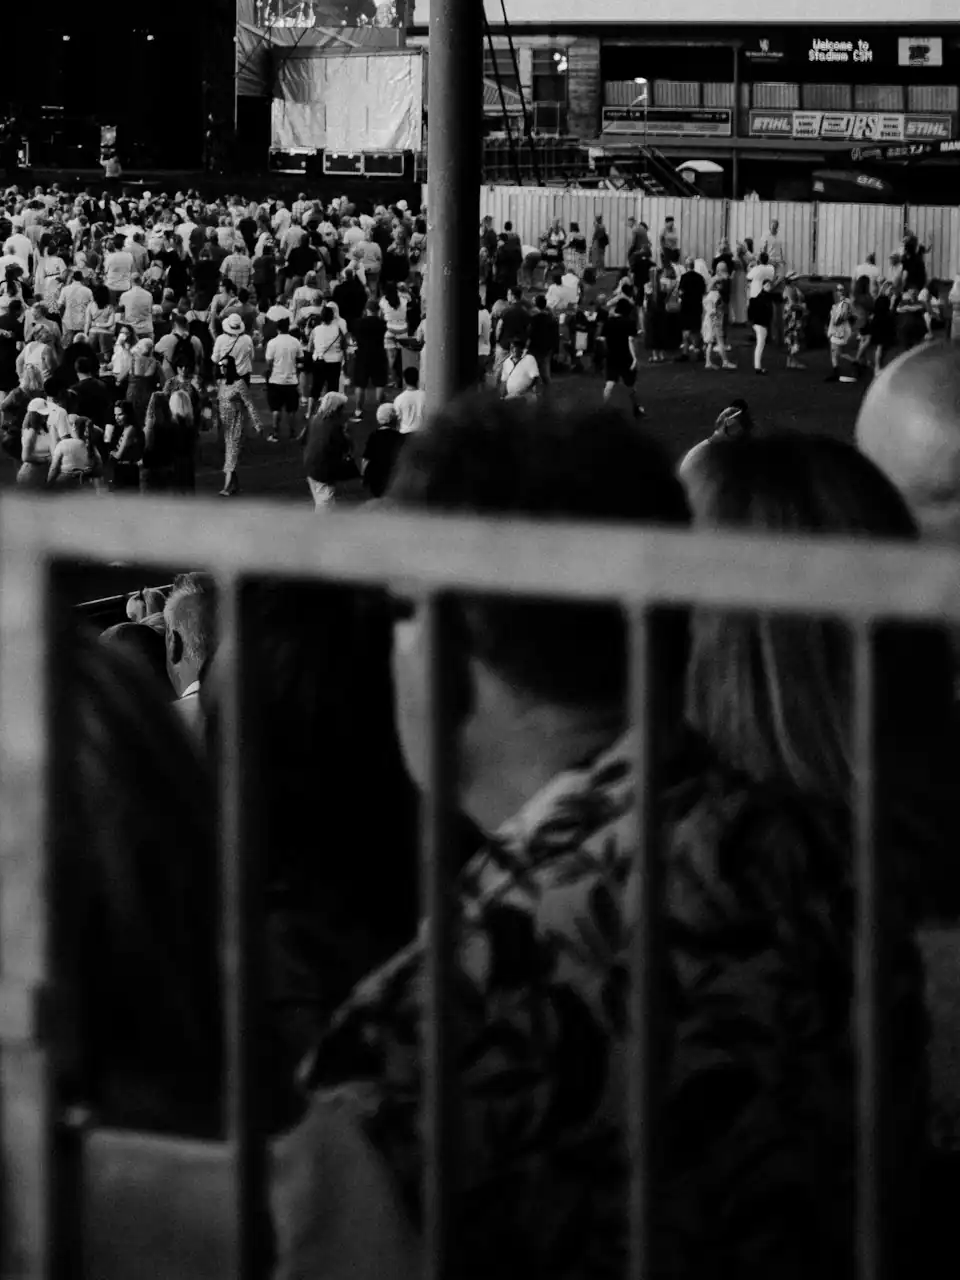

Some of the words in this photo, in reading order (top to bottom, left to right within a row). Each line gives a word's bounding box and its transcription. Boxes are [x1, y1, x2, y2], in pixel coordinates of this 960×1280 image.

[812, 38, 853, 51] Welcome
[857, 39, 869, 51] to
[808, 49, 848, 62] Stadium
[752, 117, 791, 131] STIHL
[905, 121, 948, 136] STIHL
